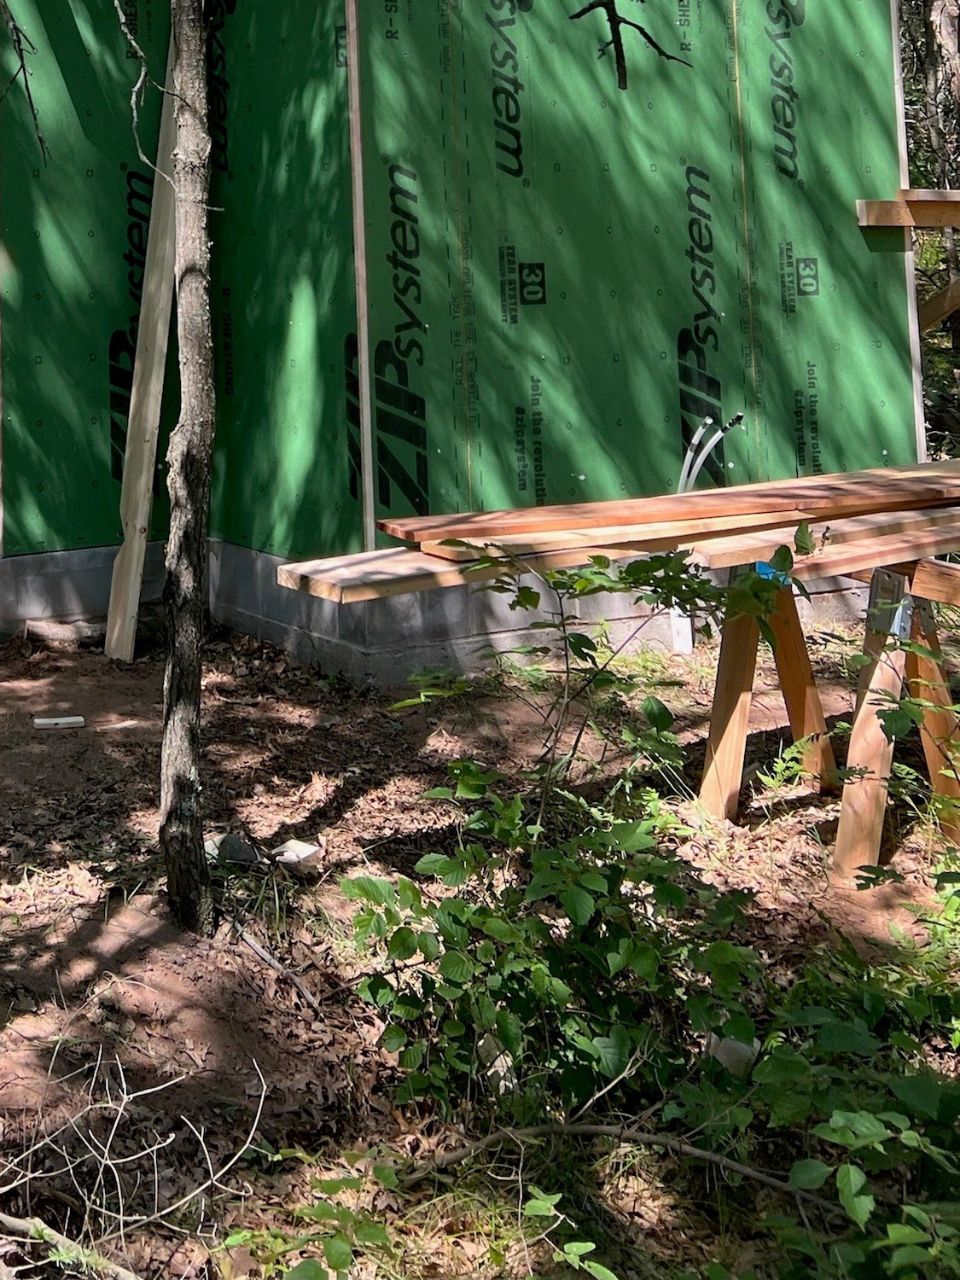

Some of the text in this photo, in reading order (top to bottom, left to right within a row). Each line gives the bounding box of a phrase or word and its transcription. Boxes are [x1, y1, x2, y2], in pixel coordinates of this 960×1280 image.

[507, 245, 519, 325] YEAR SYSTEM
[522, 268, 544, 302] 30
[798, 261, 818, 293] 30
[530, 375, 542, 406] Join
[807, 361, 818, 389] Join
[809, 394, 820, 417] the
[531, 412, 544, 435] the
